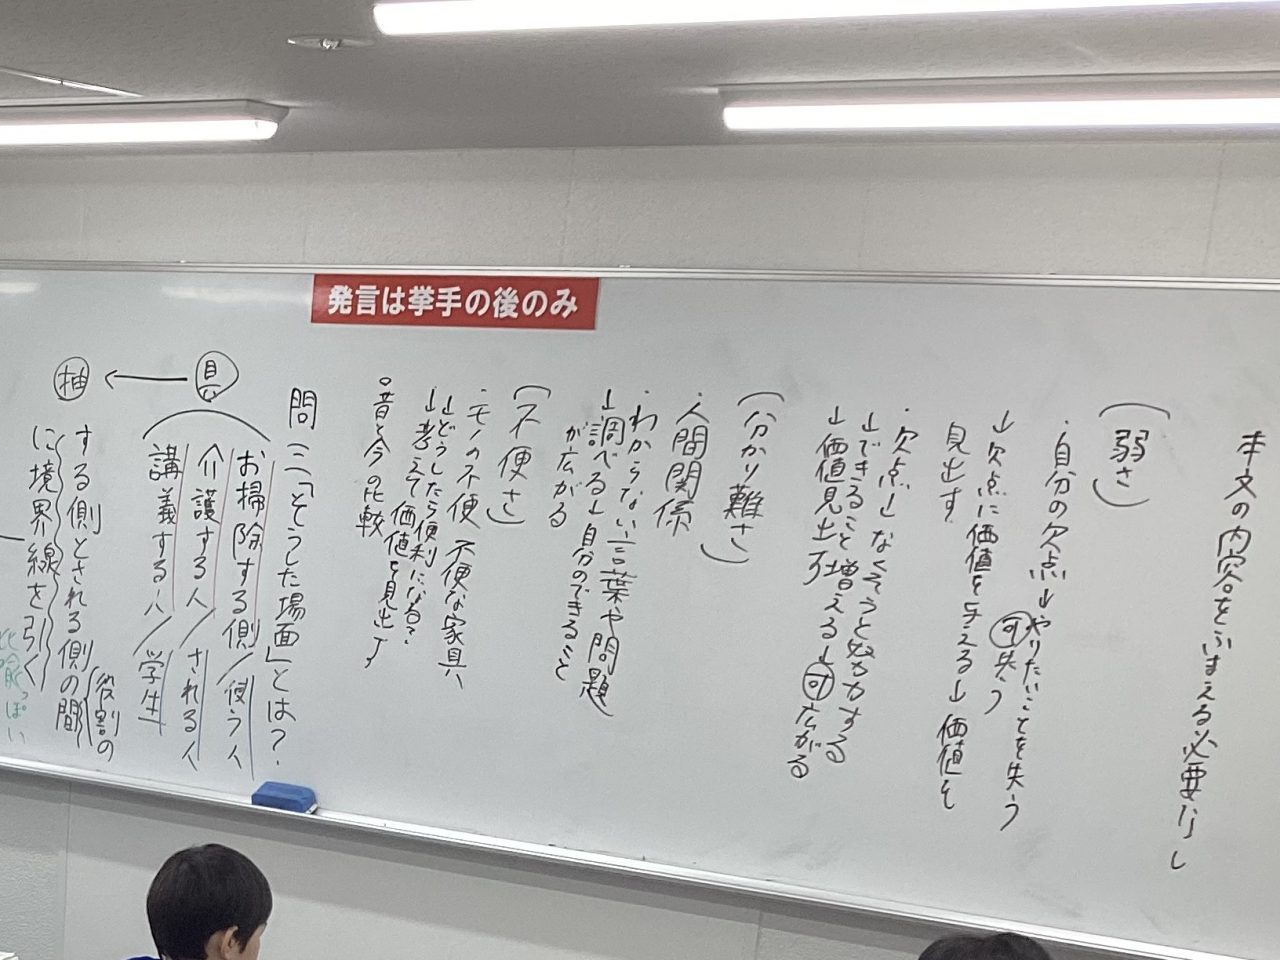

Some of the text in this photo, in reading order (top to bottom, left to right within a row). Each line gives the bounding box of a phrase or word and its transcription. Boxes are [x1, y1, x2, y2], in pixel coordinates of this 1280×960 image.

[328, 284, 578, 319] 発言は挙手の後のみ
